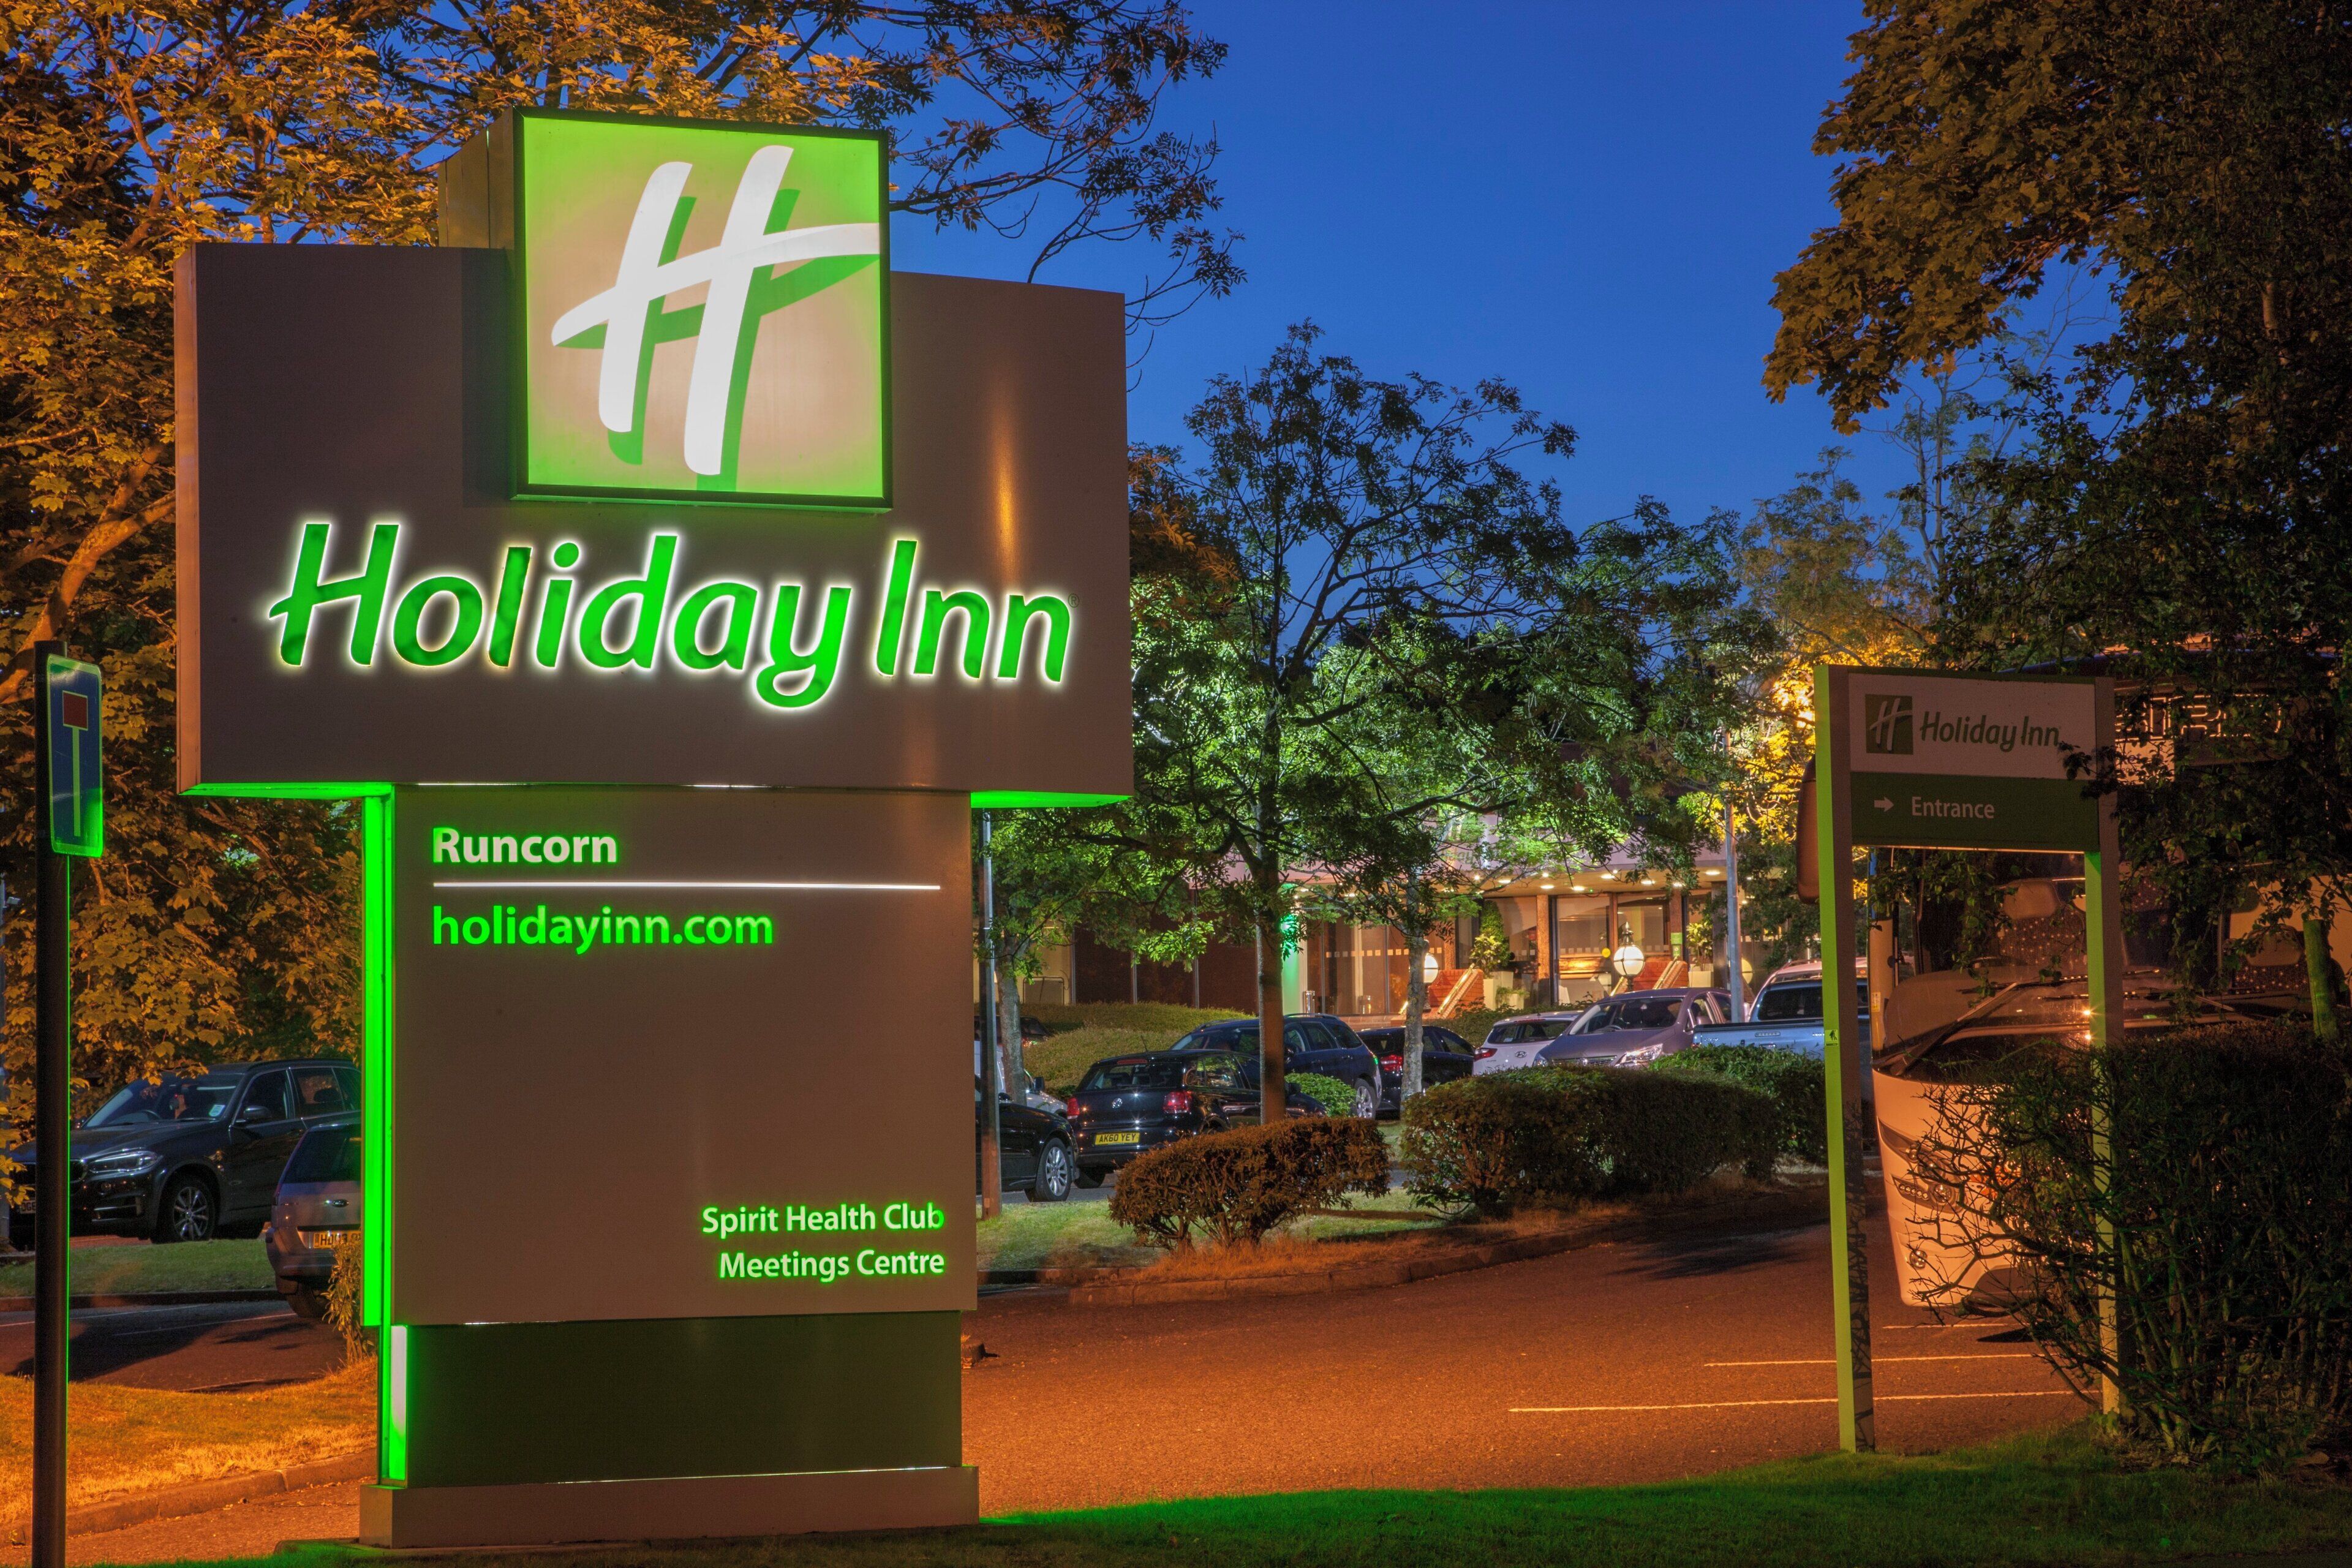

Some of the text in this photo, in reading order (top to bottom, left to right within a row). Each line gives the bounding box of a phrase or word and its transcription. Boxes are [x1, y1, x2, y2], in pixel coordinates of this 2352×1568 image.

[270, 522, 851, 709] Holiday
[1920, 711, 2060, 752] Holiday Inn
[1912, 796, 1995, 819] Entrance
[432, 827, 617, 863] Runcorn
[432, 905, 773, 955] holidayinn.com
[1099, 1133, 1136, 1142] AK60 YEY
[703, 1202, 944, 1239] Spirit Health Club
[720, 1250, 944, 1283] Meetings Centre
